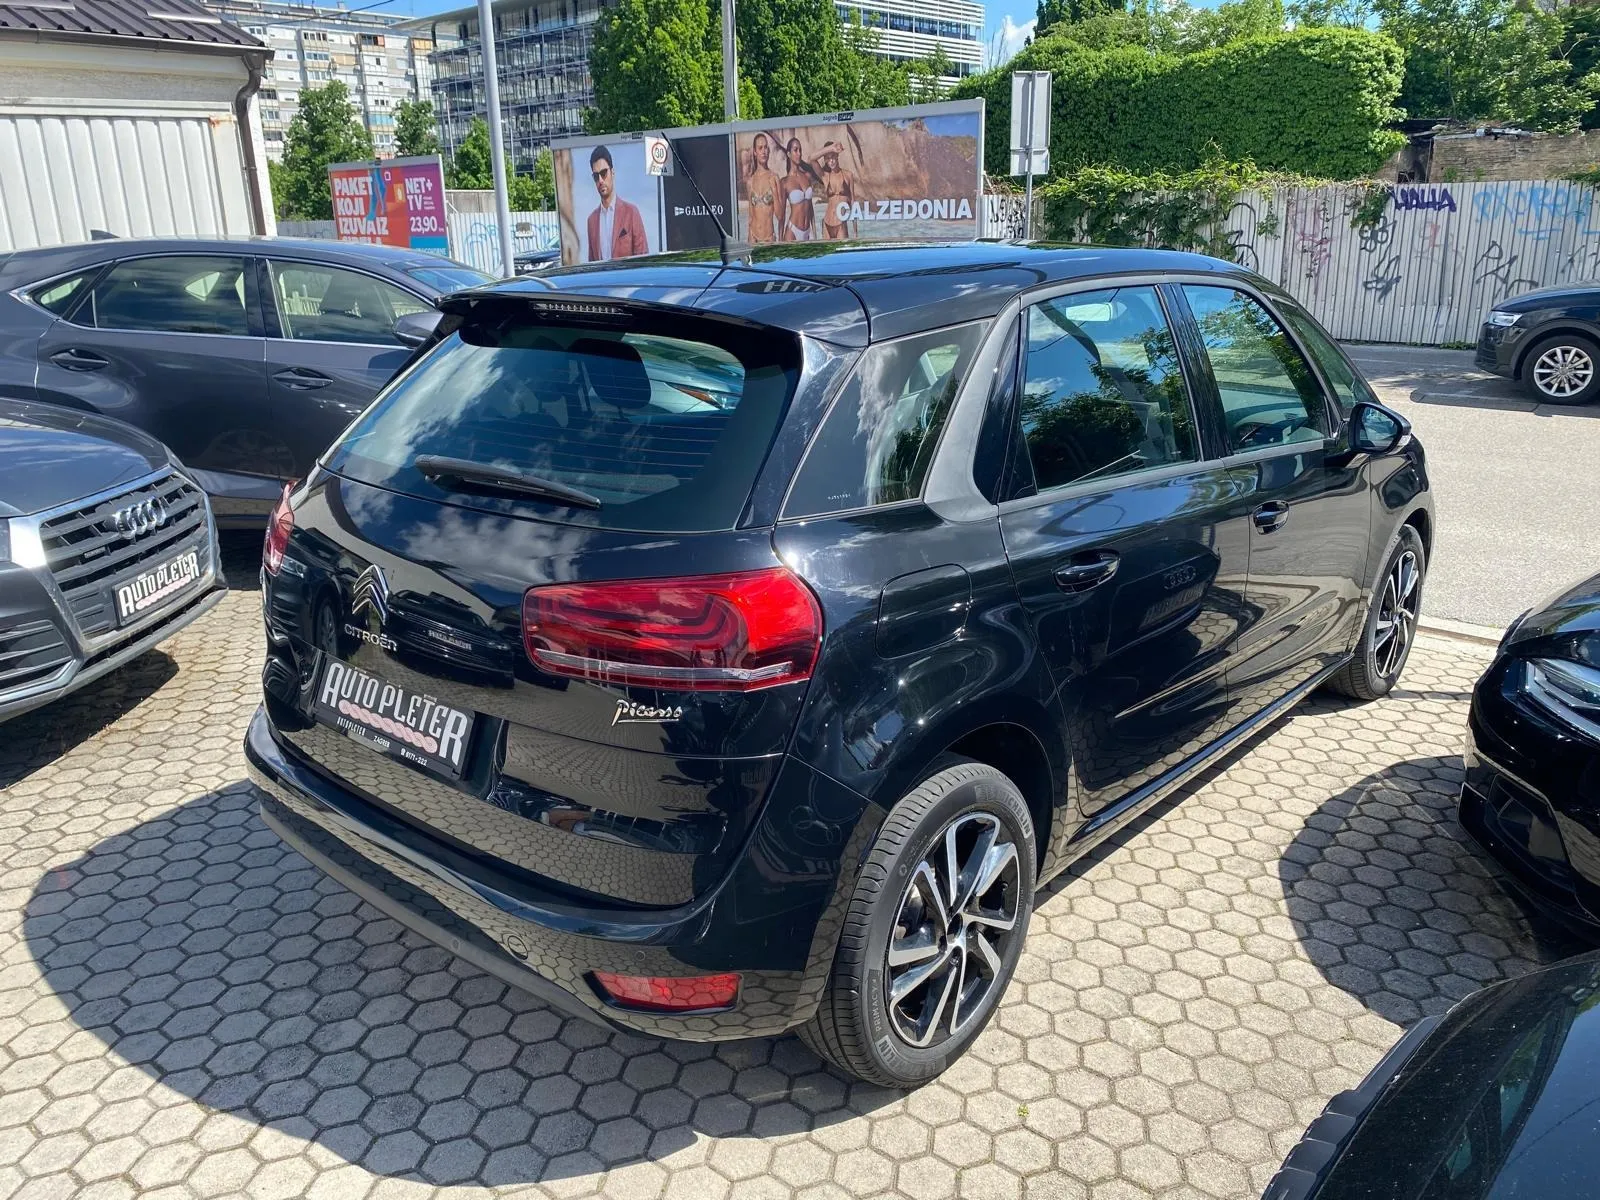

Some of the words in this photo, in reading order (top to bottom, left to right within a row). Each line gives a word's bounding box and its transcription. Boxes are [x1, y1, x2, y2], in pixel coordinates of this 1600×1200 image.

[655, 147, 665, 159] 30
[333, 176, 373, 196] PAKET
[404, 177, 433, 195] NET+
[336, 197, 365, 216] KOJI
[406, 194, 423, 211] TV
[835, 198, 973, 222] CALZEDONIA
[410, 216, 438, 234] 23,90
[118, 576, 156, 618] AUTO
[156, 552, 199, 588] PLETER
[344, 623, 398, 652] CITROËN
[321, 662, 379, 709] AUTO
[377, 684, 468, 766] PLETER
[611, 699, 683, 727] Picasso
[871, 986, 883, 1033] PRIMACY
